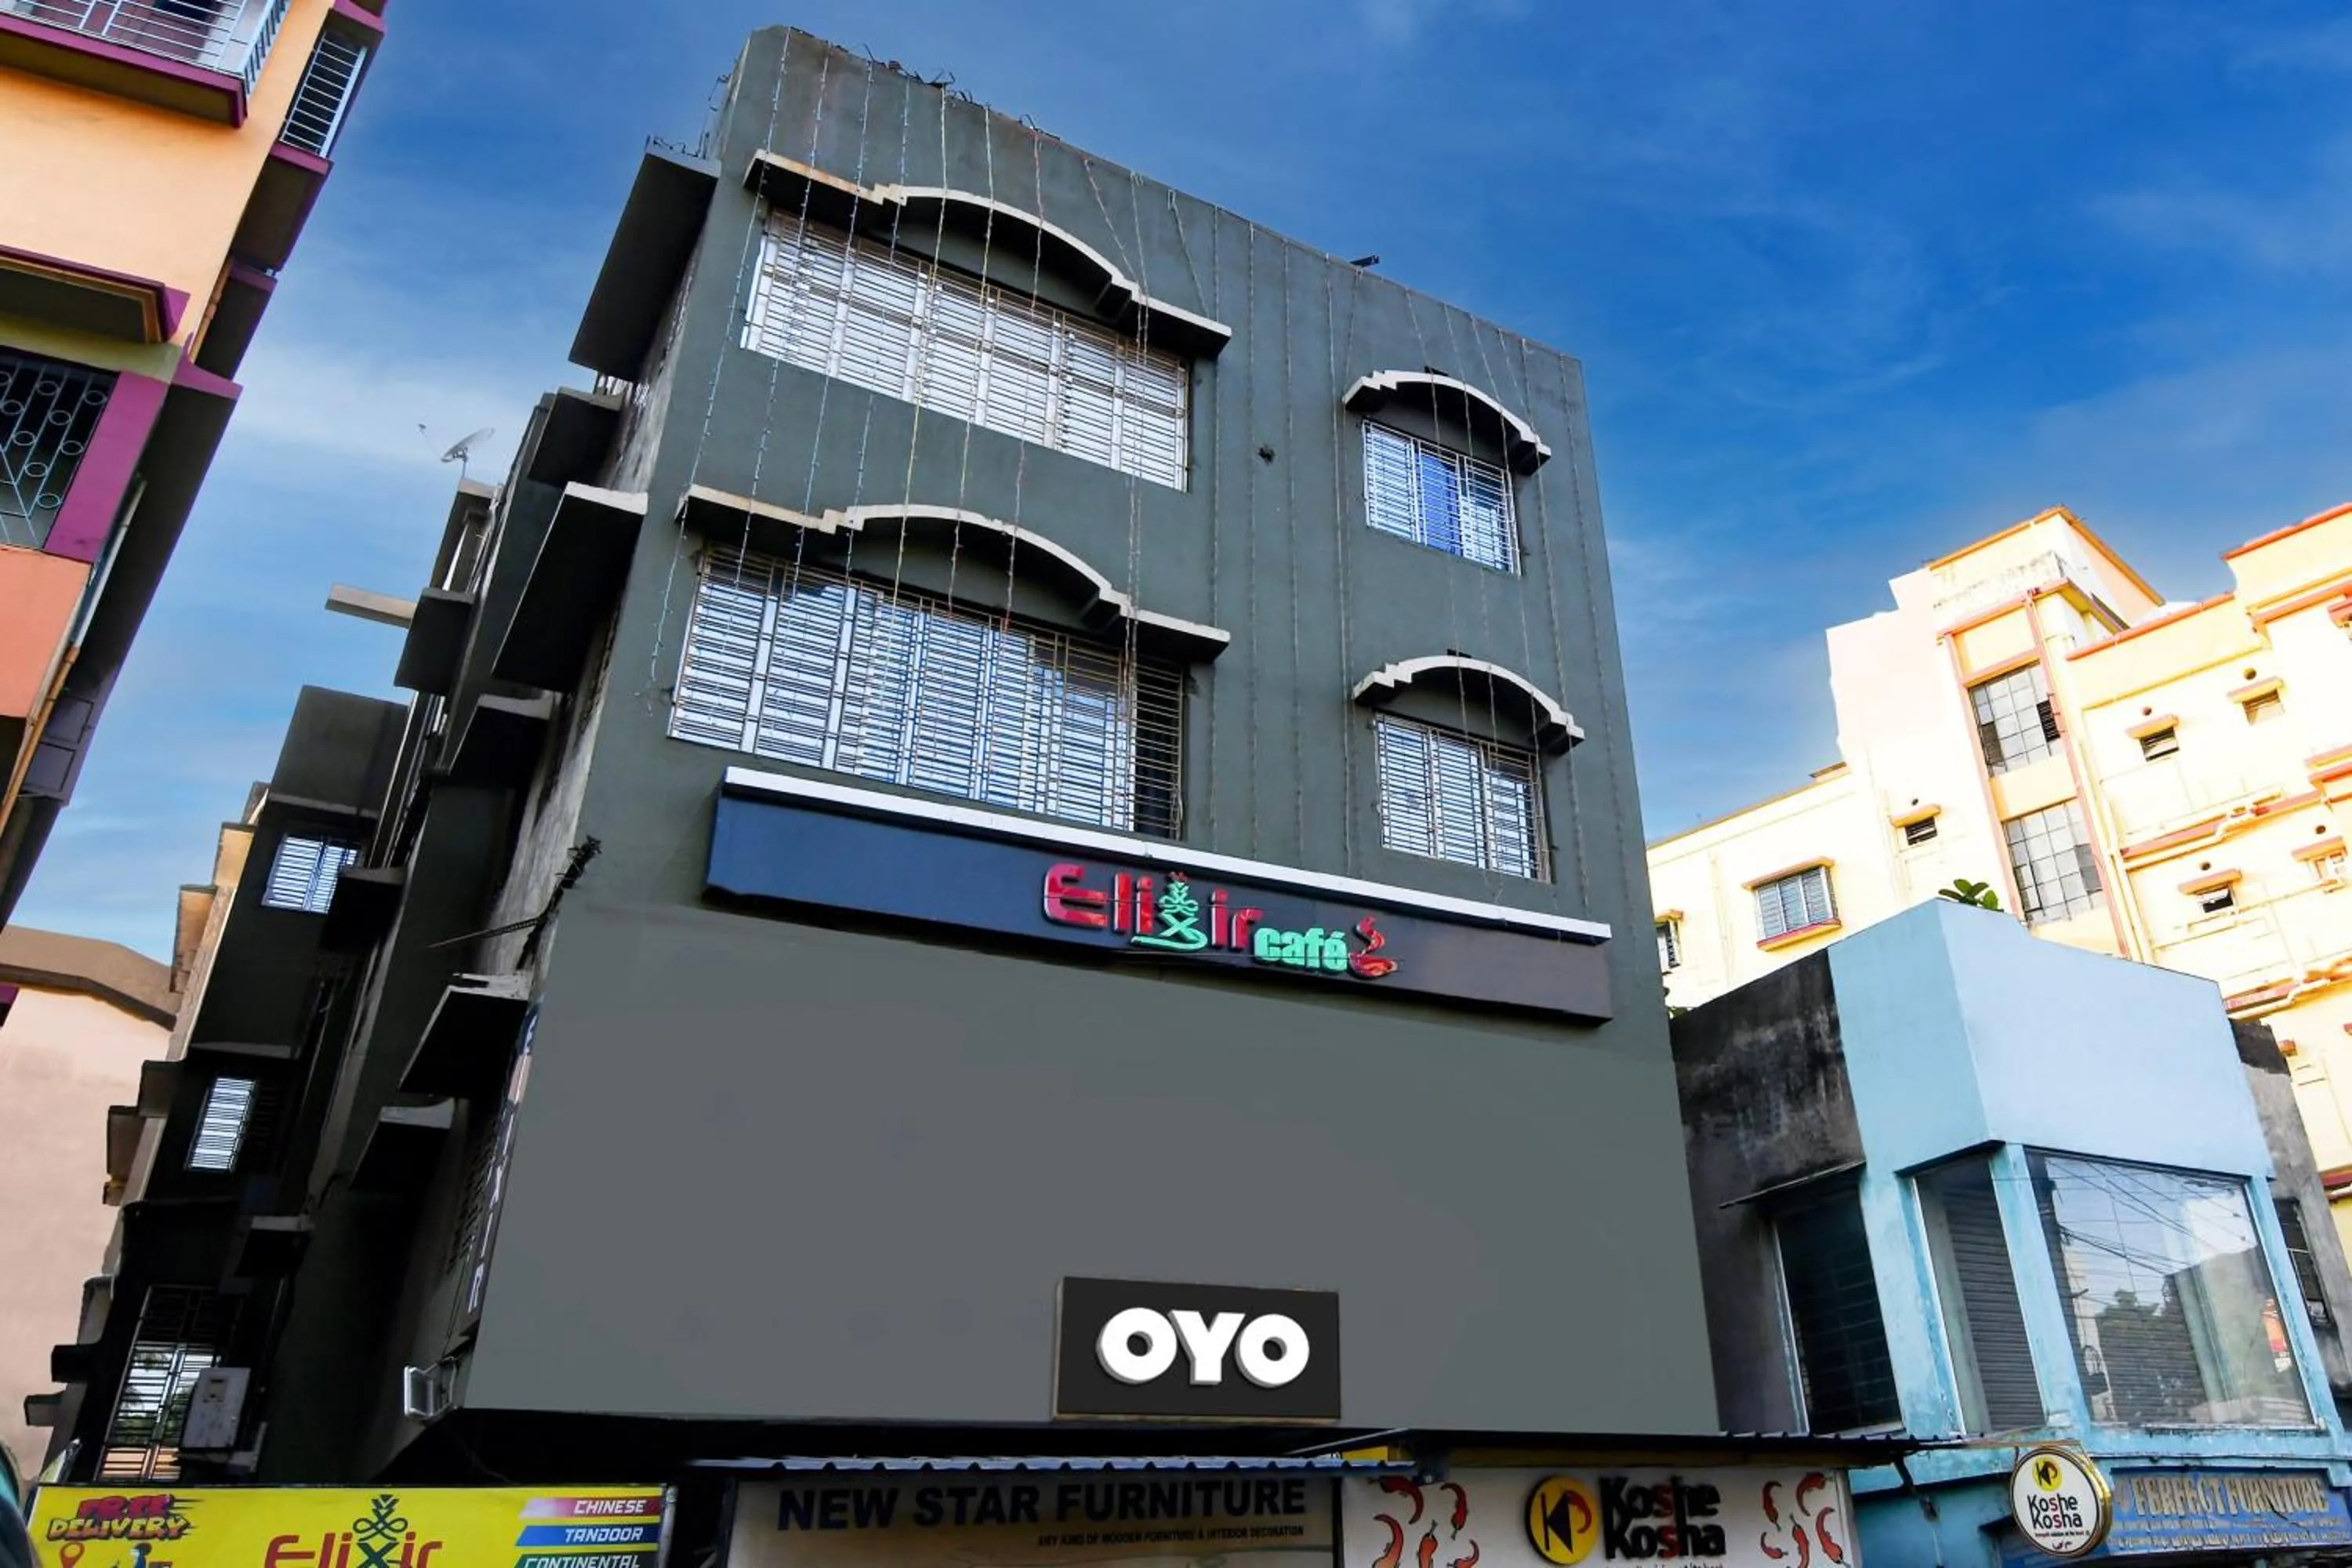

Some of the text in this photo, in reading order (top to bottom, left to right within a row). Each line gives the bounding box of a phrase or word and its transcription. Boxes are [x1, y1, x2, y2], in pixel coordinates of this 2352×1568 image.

[1096, 1307, 1310, 1388] OYO
[574, 1499, 647, 1515] CHINESE
[777, 1478, 1308, 1531] NEW STAR FURNITURE
[1598, 1475, 1720, 1518] Koshe
[2027, 1493, 2078, 1512] Koshe
[2223, 1477, 2329, 1515] FURNITURE
[47, 1515, 191, 1541] DELIVERY
[2031, 1512, 2082, 1530] Kosha
[565, 1527, 644, 1543] TANDOOR
[1602, 1519, 1726, 1560] Kosha
[523, 1555, 641, 1568] CONTINENTAL
